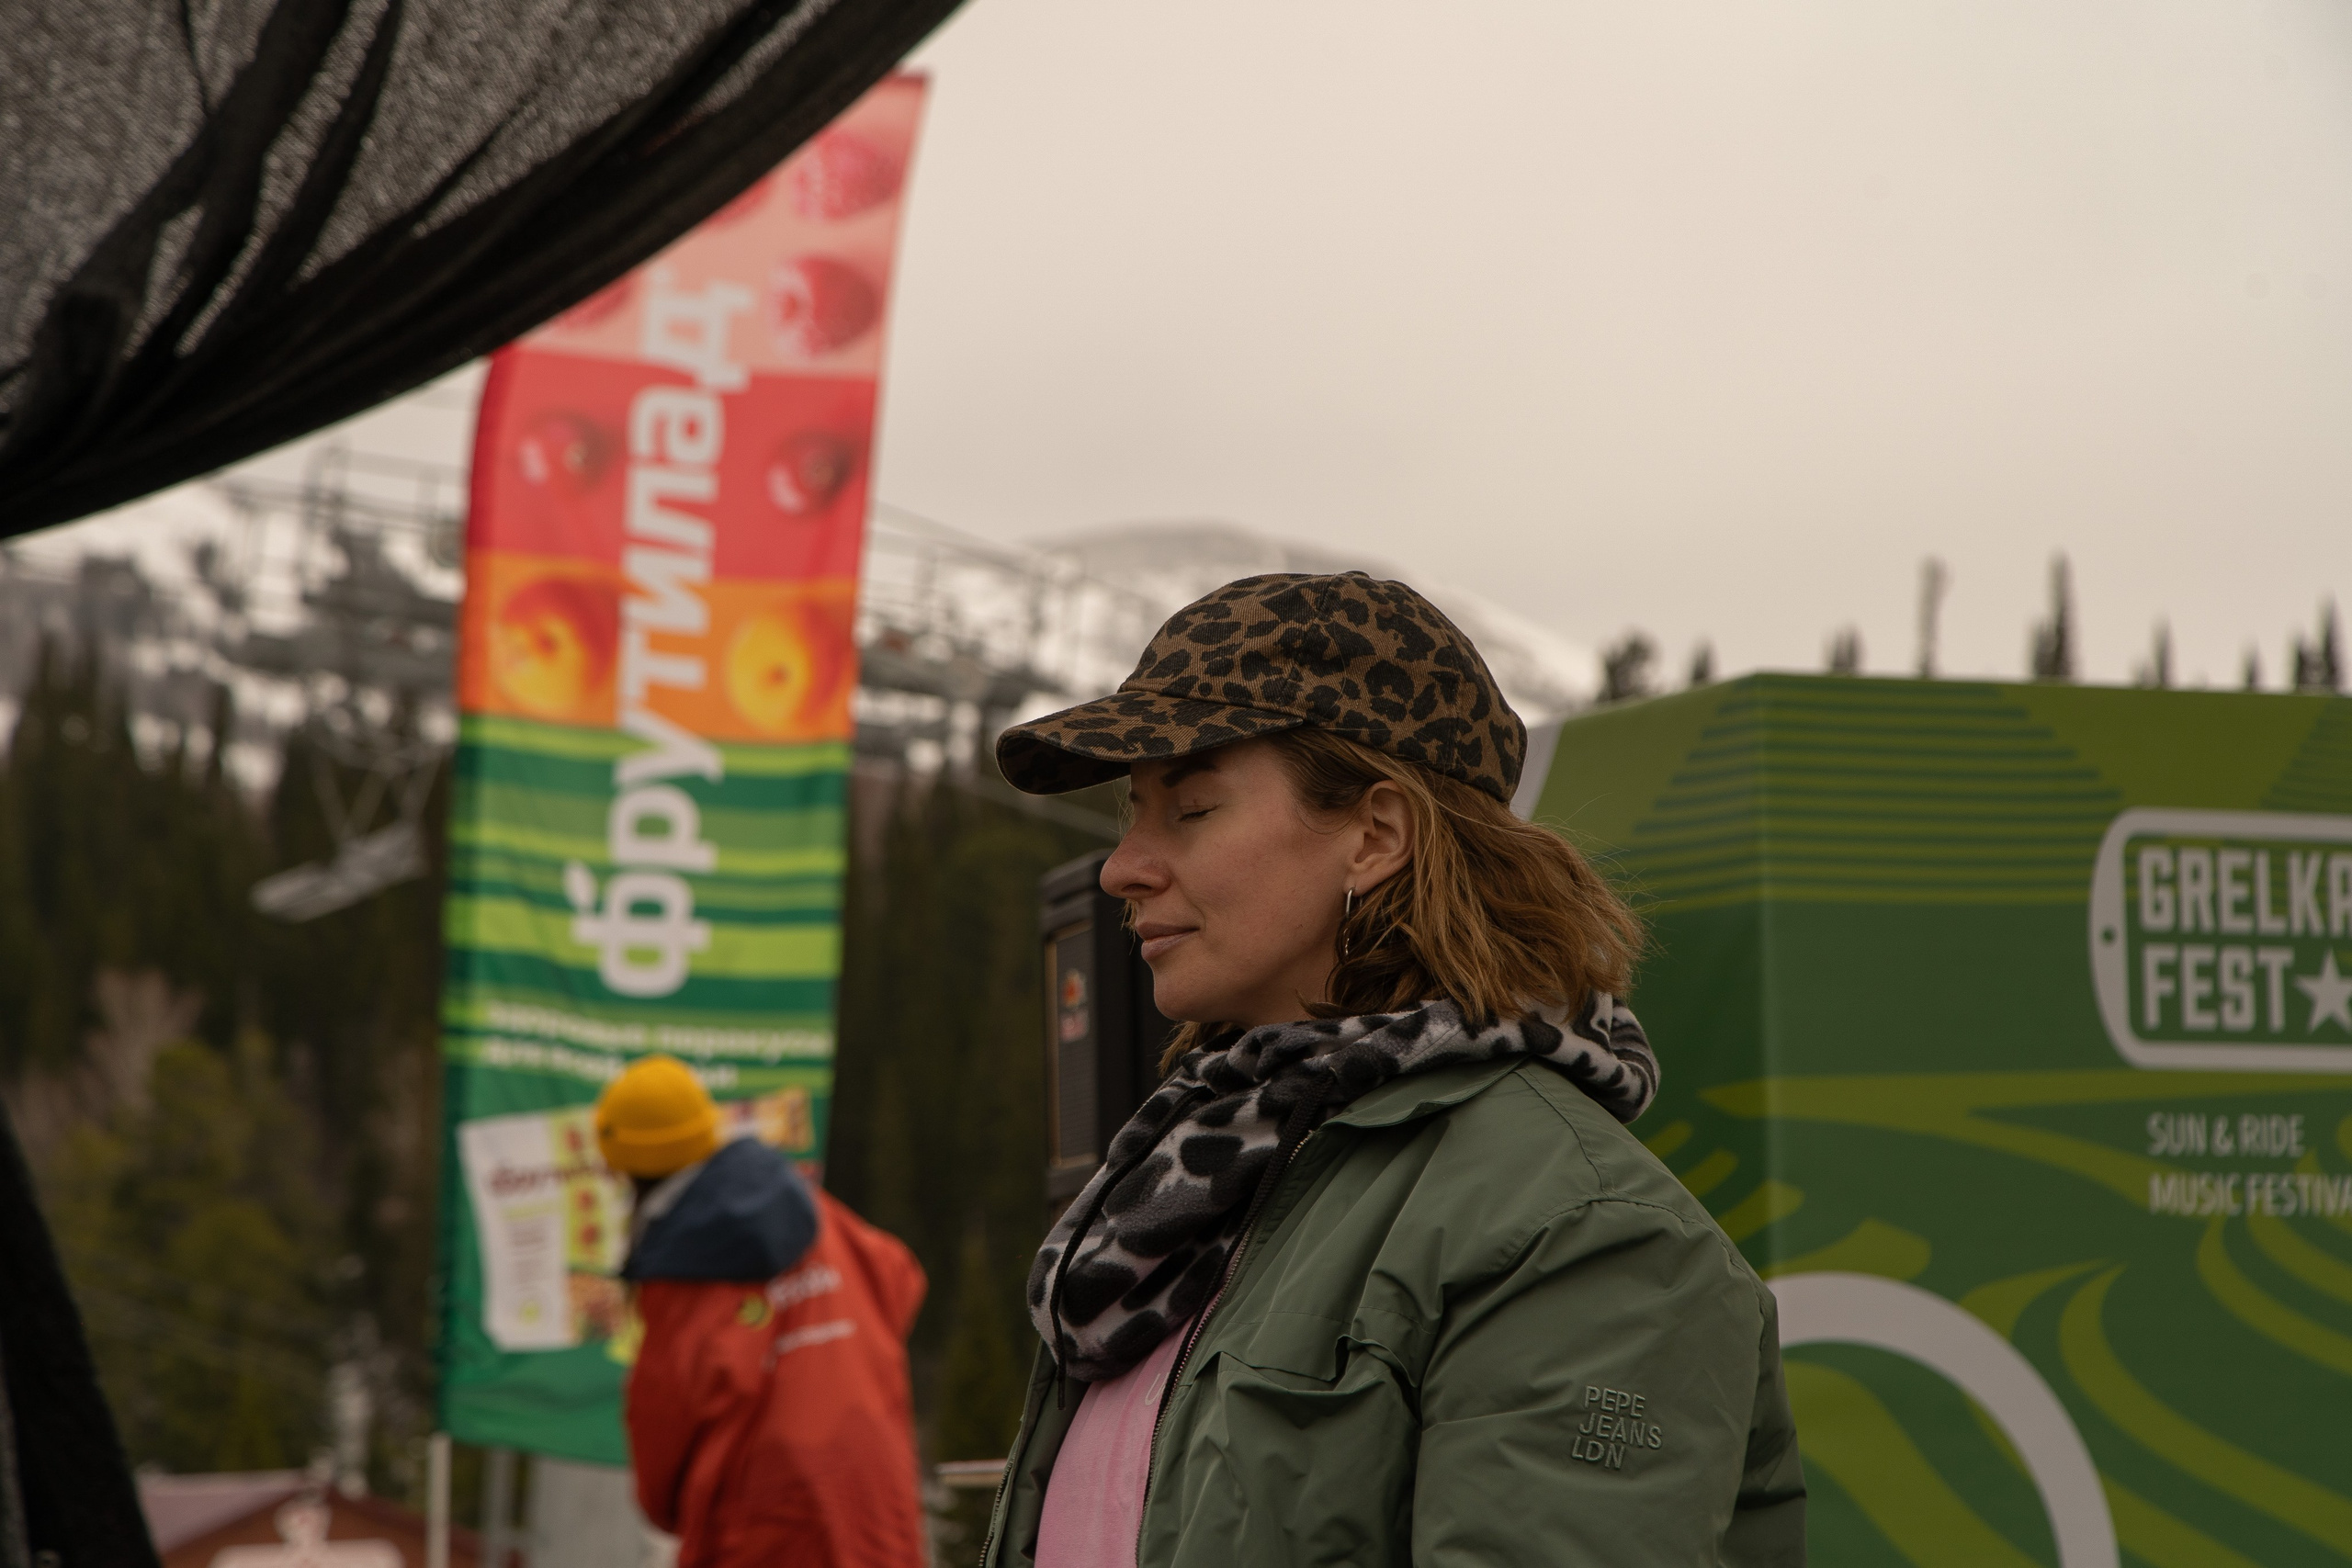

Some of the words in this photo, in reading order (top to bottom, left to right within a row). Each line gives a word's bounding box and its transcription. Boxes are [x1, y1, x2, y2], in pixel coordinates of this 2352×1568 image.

[2138, 844, 2352, 939] GRELKA
[2142, 943, 2295, 1033] FEST
[2146, 1111, 2207, 1157] SUN
[2211, 1113, 2234, 1157] &
[2238, 1113, 2305, 1158] RIDE
[2147, 1172, 2242, 1216] MUSIC
[1584, 1385, 1646, 1417] PEPE
[1578, 1412, 1663, 1450] JEANS
[1571, 1436, 1626, 1471] LDN
